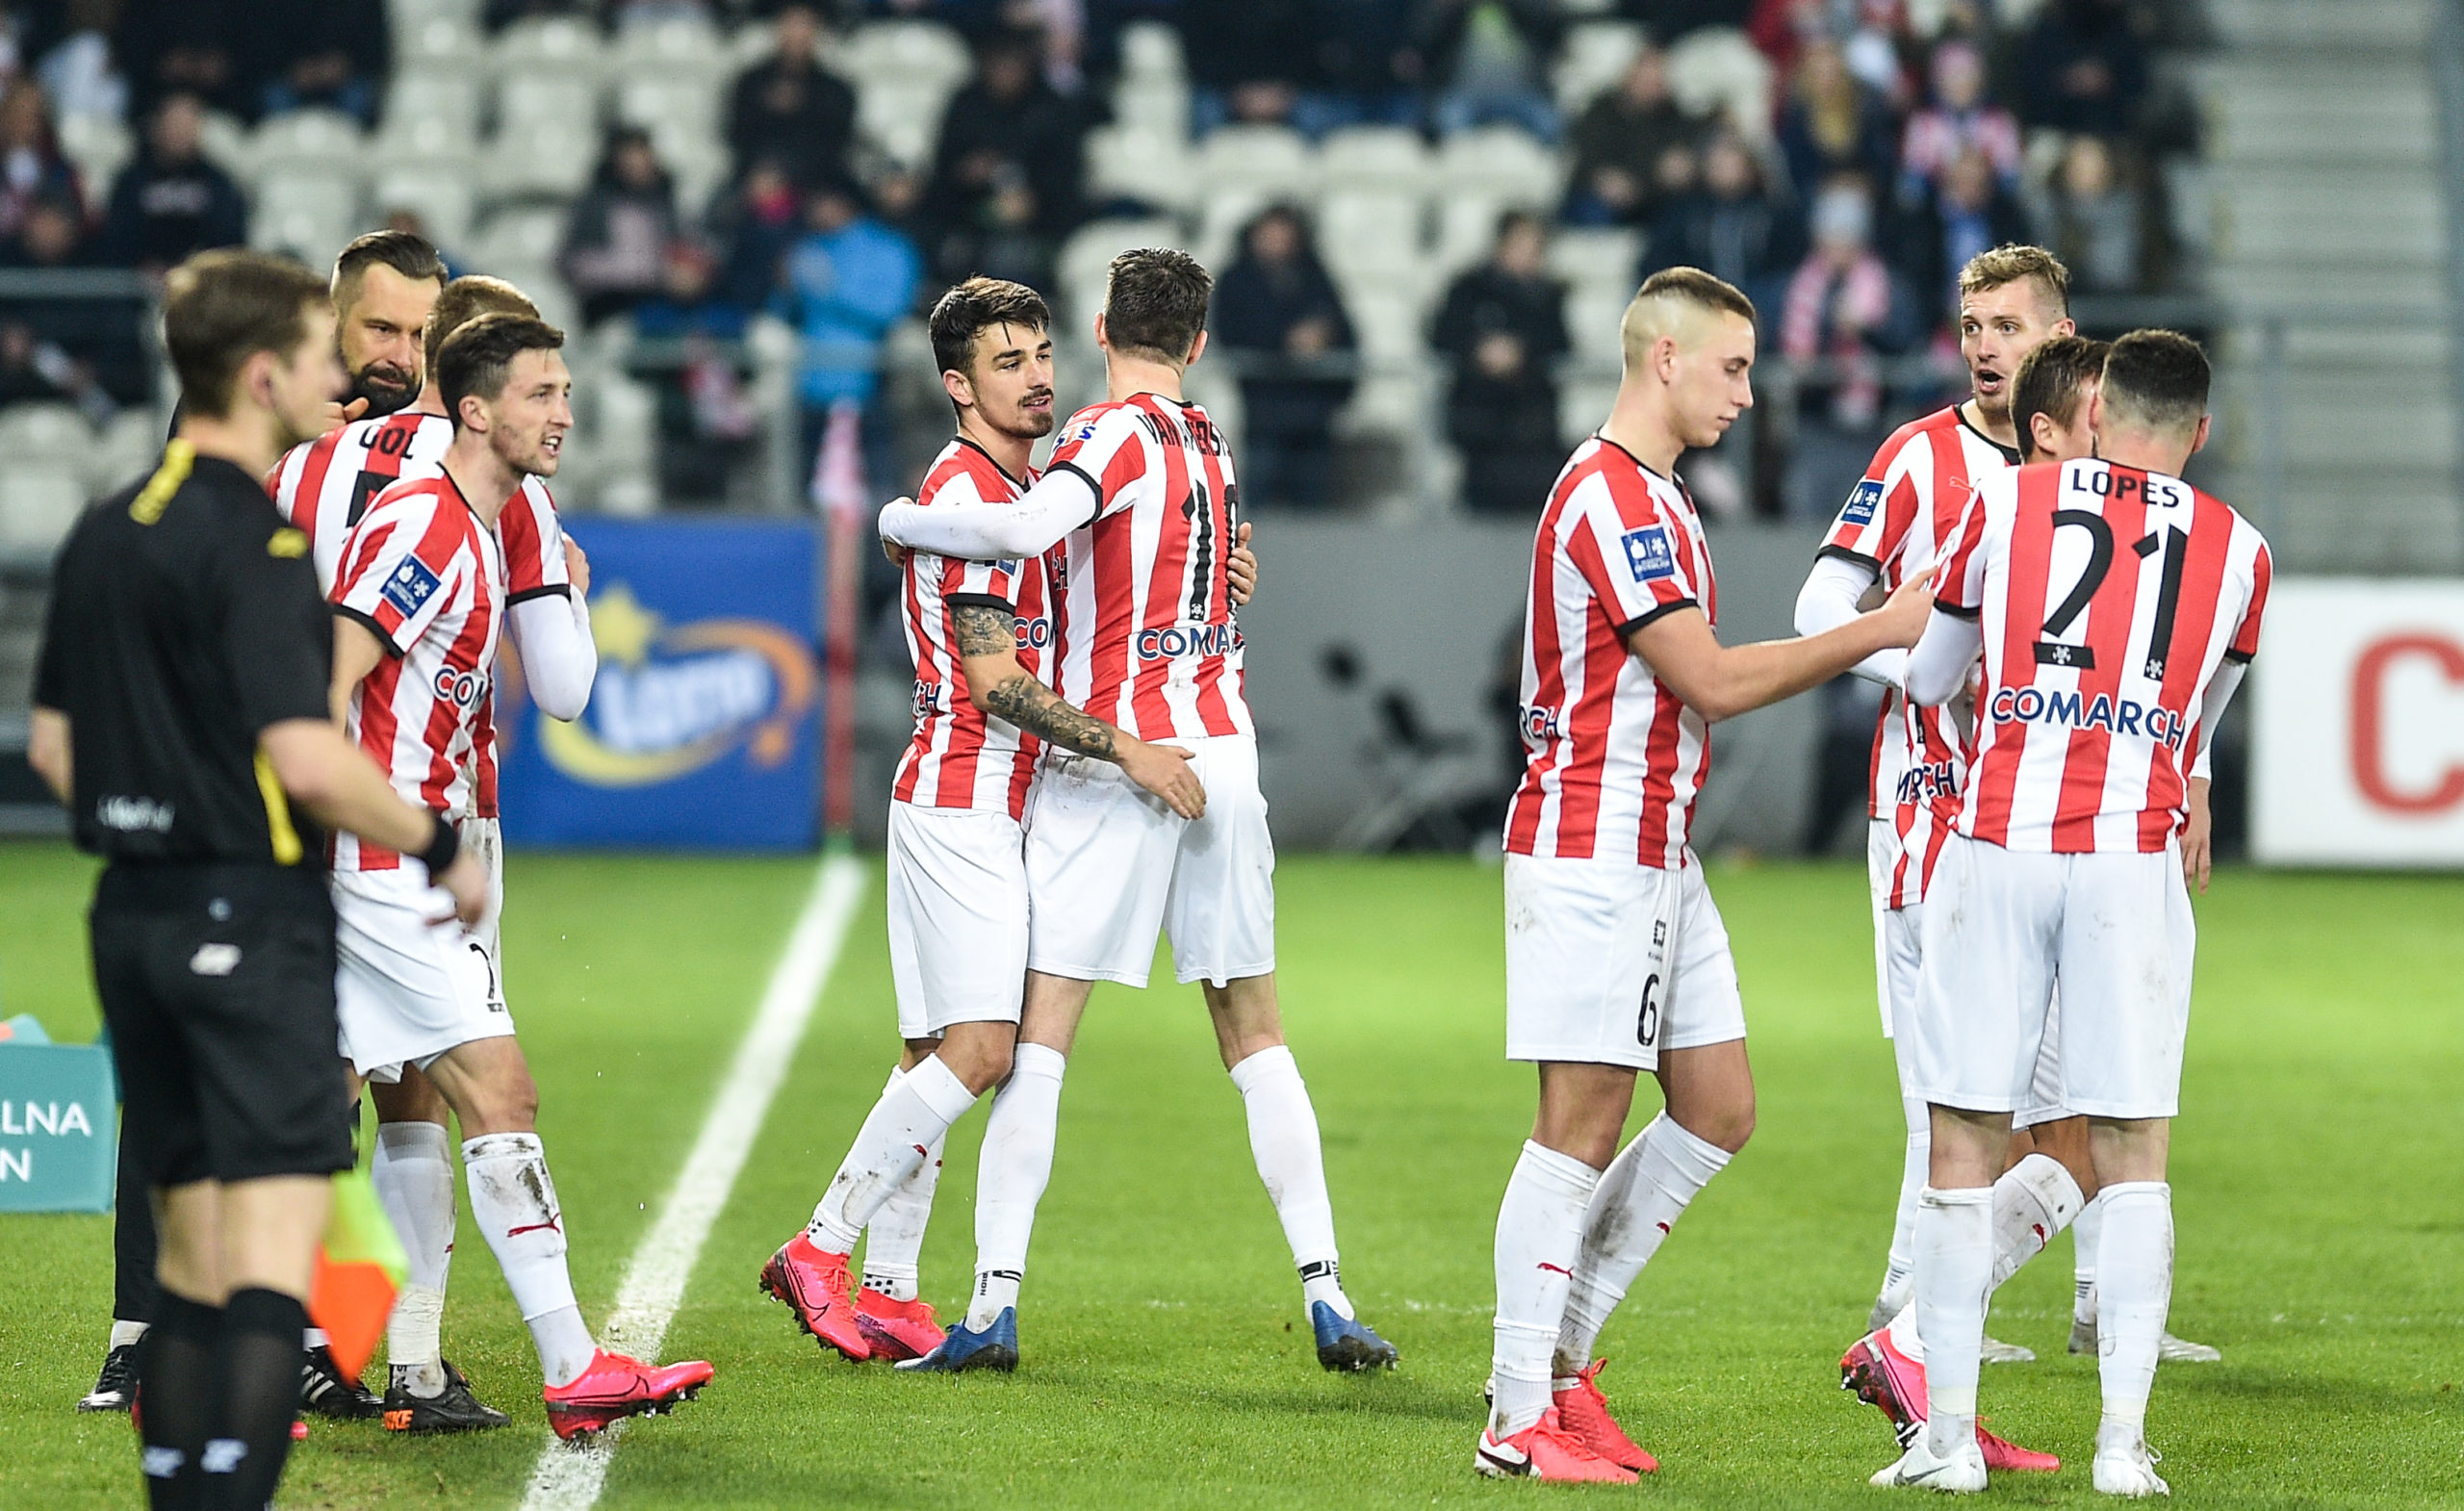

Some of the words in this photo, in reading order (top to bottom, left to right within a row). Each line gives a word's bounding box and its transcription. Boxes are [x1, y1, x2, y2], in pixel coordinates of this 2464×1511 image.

[1135, 412, 1181, 448] VAN
[2071, 467, 2181, 507] LOPES
[2032, 508, 2189, 682] 21
[1989, 688, 2186, 752] COMARCH
[1636, 972, 1660, 1047] 6
